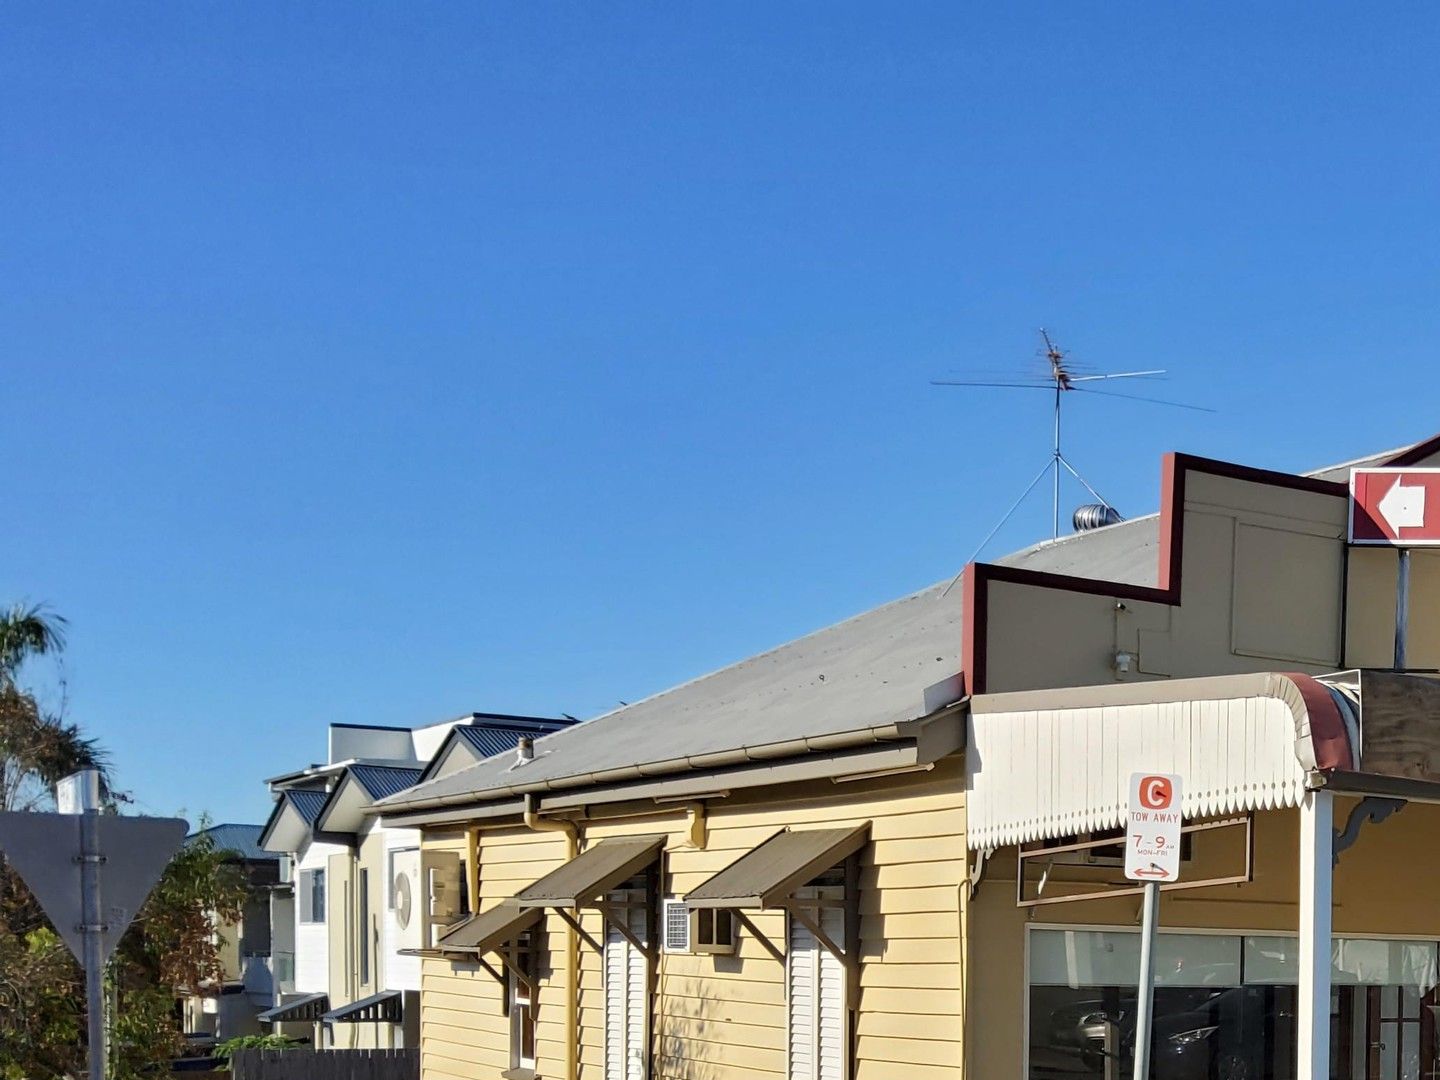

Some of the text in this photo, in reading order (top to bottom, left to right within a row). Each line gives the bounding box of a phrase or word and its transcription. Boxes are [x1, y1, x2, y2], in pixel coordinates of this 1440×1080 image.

[1147, 780, 1165, 806] C
[1131, 811, 1179, 824] TOW AWAY
